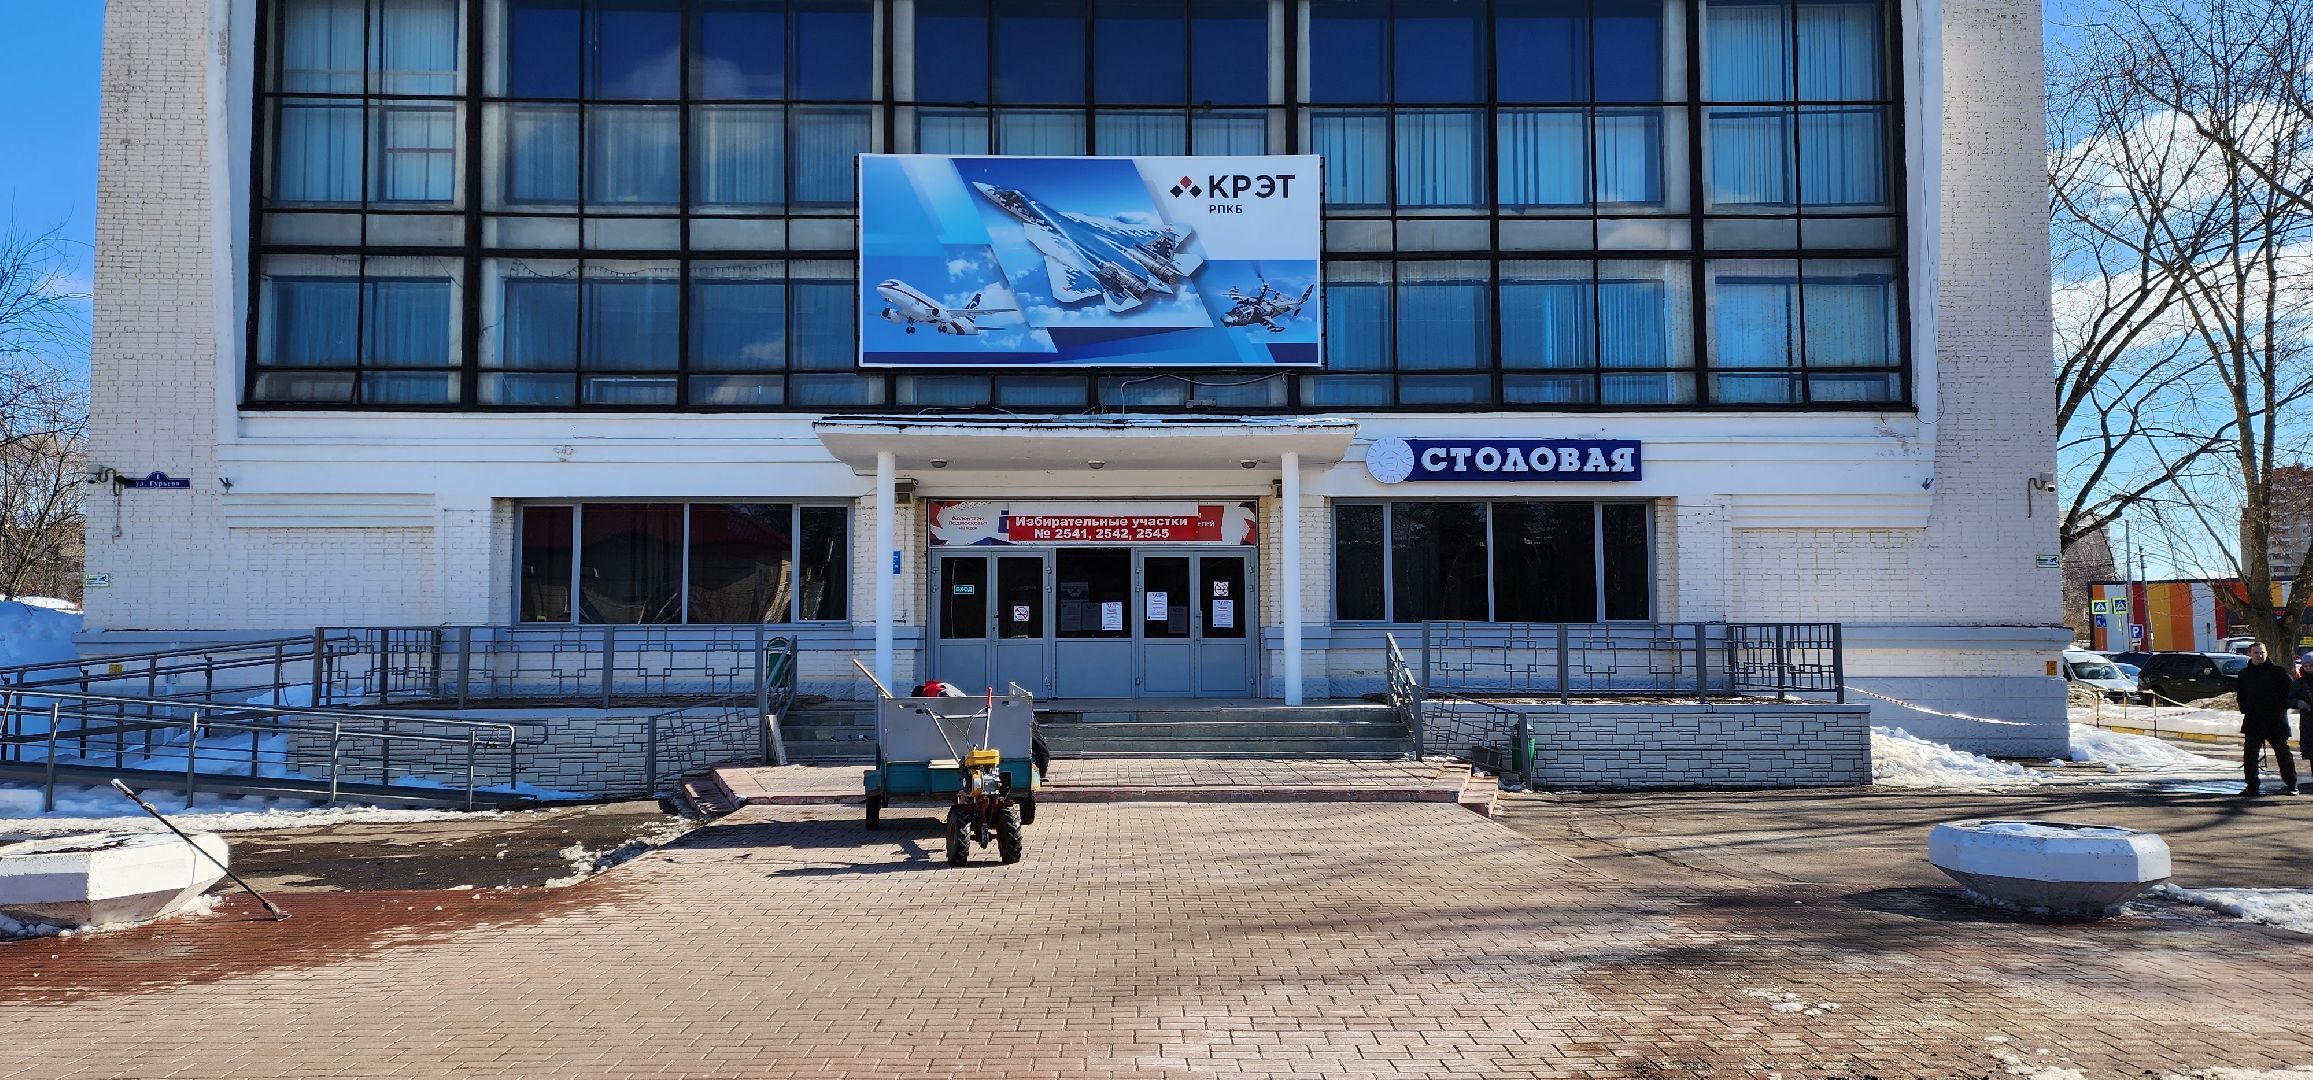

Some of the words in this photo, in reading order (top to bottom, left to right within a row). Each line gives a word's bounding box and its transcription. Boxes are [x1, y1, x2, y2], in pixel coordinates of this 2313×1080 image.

[1208, 174, 1296, 199] КРЭТ
[1209, 204, 1243, 214] РПКБ
[1420, 446, 1635, 473] СТОЛОВАЯ
[1015, 516, 1129, 528] Избирательные
[1132, 517, 1188, 528] участки
[1034, 528, 1051, 539] №
[1054, 528, 1092, 541] 2541,
[1095, 528, 1133, 541] 2542,
[1136, 528, 1170, 539] 2545
